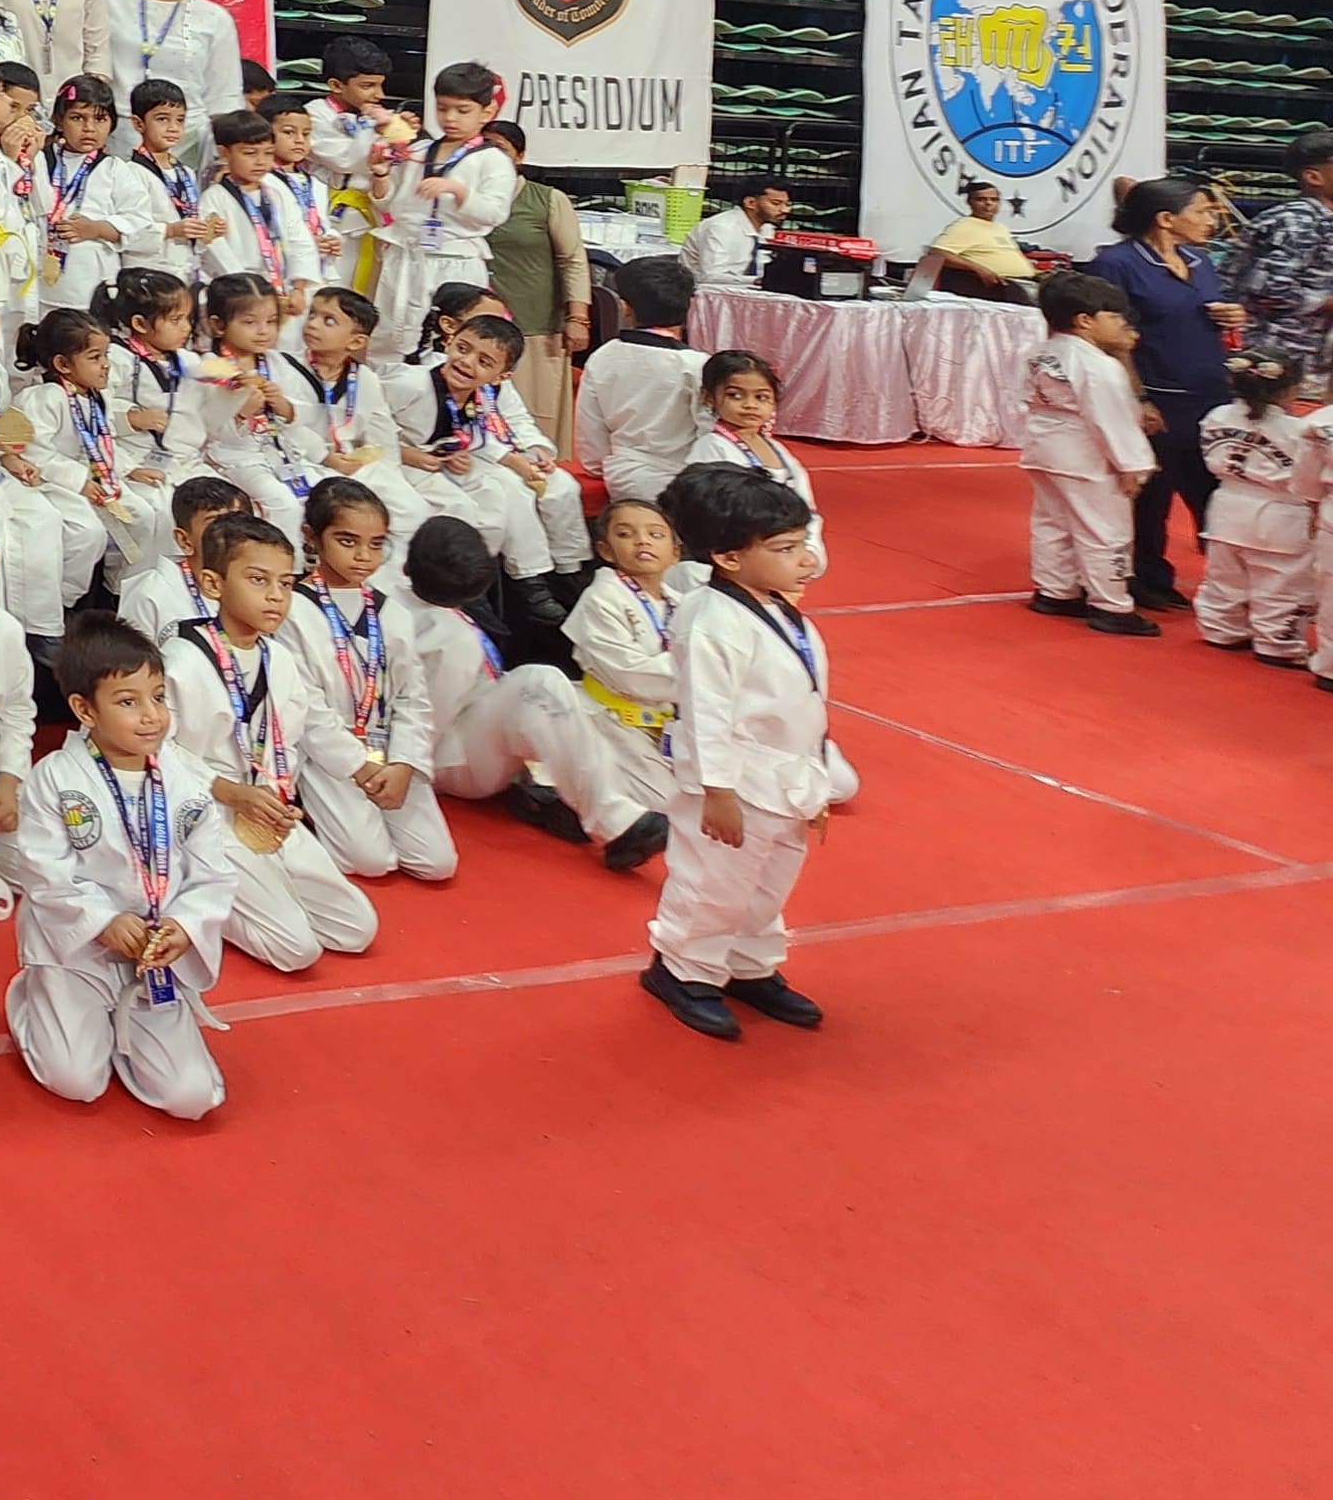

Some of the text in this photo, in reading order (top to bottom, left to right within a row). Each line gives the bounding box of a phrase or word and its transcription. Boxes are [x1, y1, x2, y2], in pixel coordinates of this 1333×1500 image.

[515, 72, 683, 132] PRESIDIUM
[900, 69, 976, 196] ASIAN
[994, 140, 1038, 163] ITF
